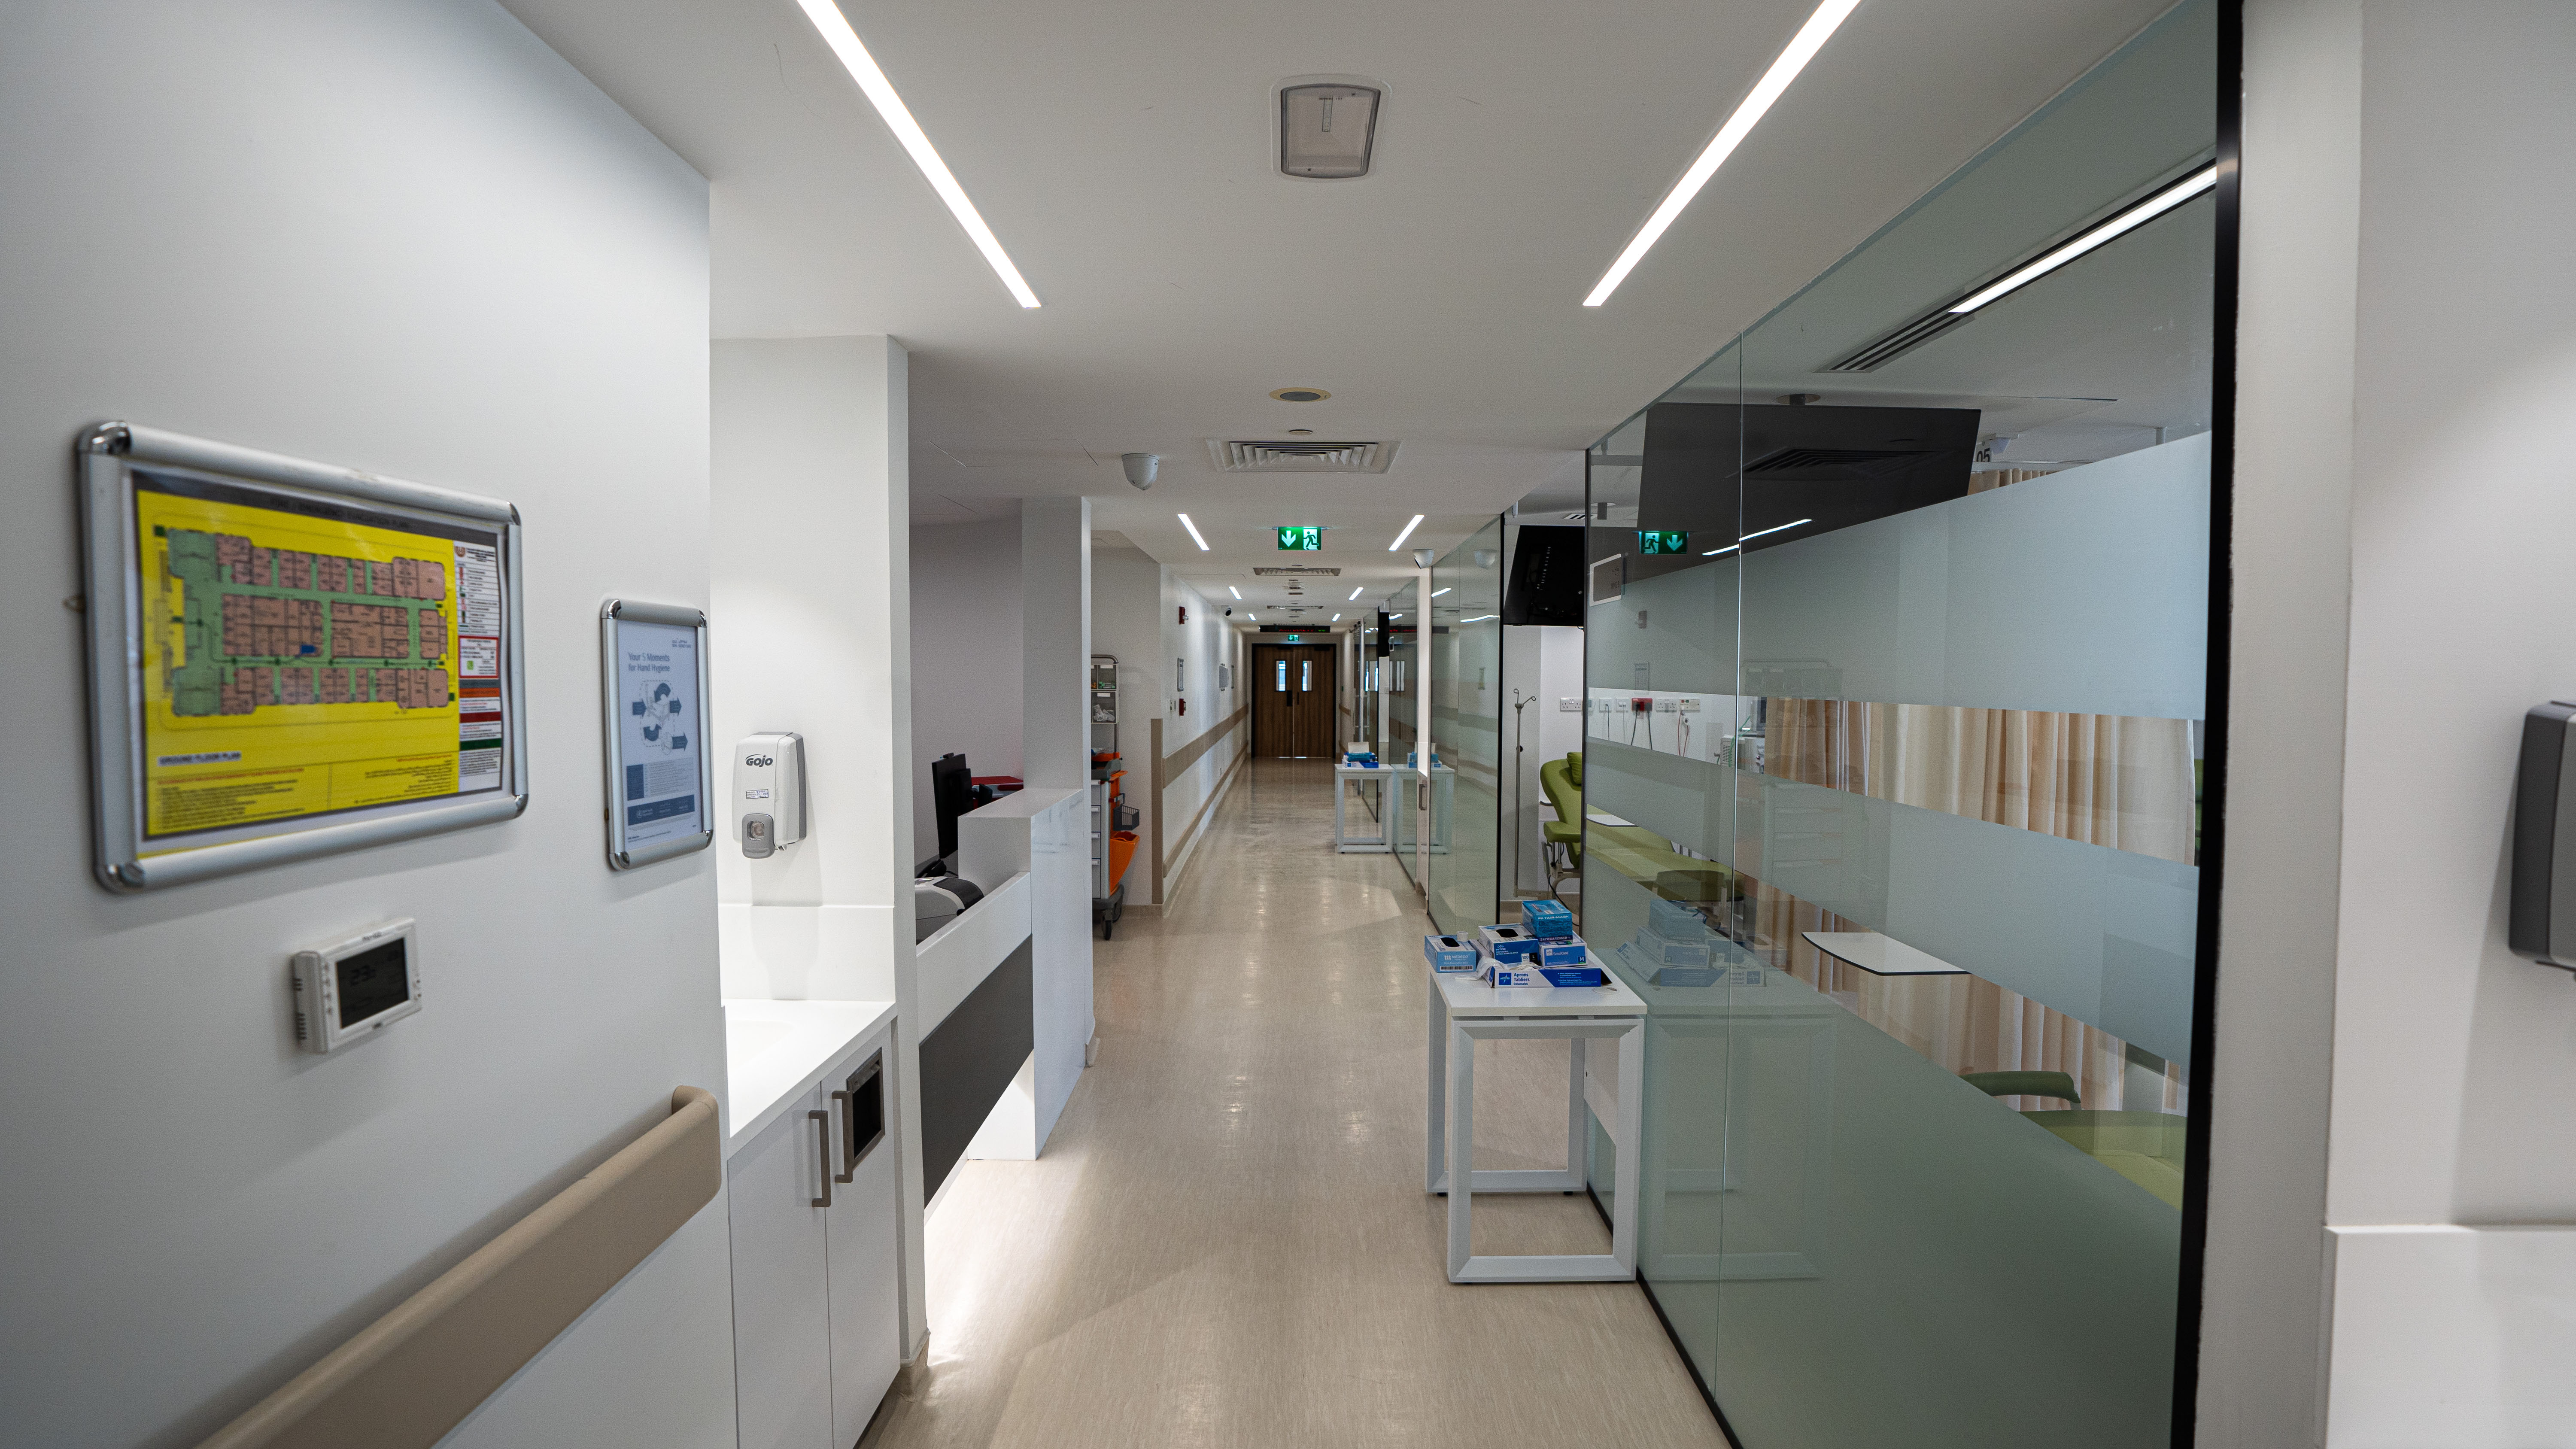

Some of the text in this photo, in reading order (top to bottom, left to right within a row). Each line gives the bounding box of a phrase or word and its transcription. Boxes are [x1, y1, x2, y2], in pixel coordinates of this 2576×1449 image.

[1976, 447, 1990, 462] 05
[628, 652, 670, 662] Your 5 Moments
[651, 663, 670, 673] Hygiene
